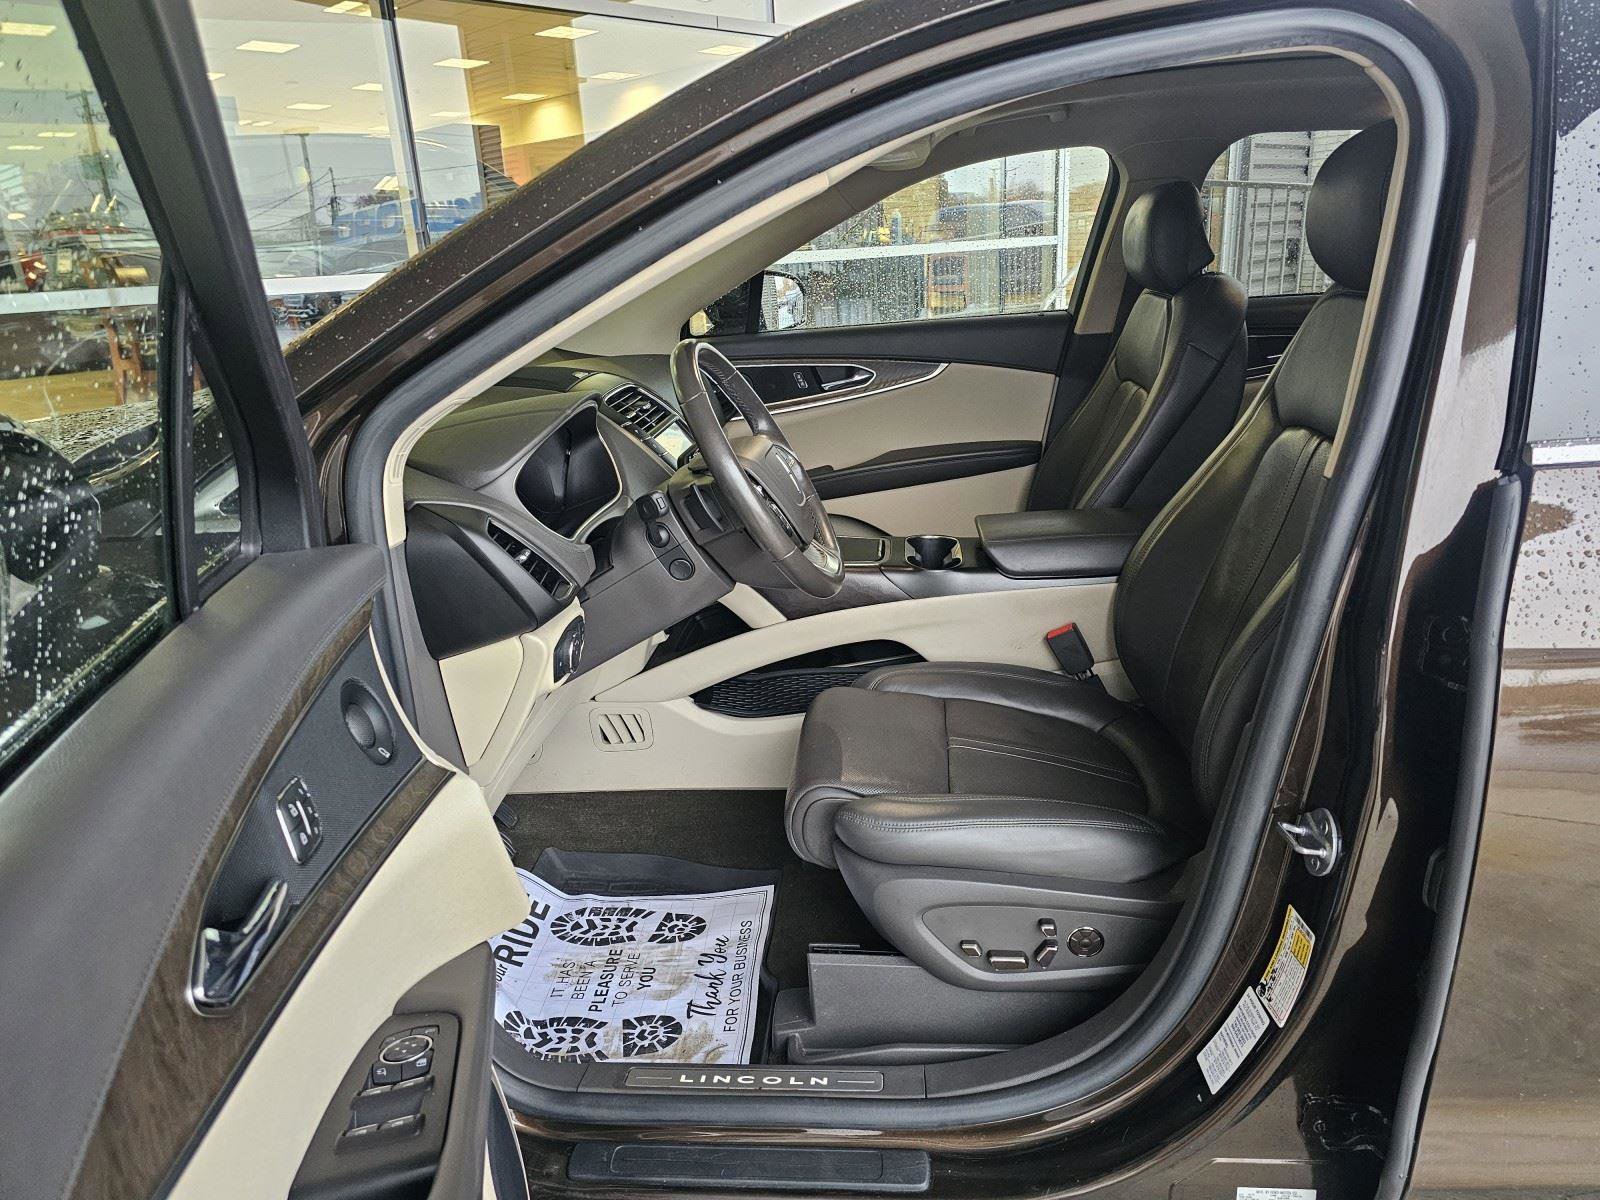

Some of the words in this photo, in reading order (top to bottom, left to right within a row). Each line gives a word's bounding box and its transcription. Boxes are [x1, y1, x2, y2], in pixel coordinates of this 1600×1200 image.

[697, 934, 729, 967] You
[733, 920, 752, 971] BUSINESS
[556, 961, 576, 984] HAS
[571, 971, 594, 1000] BEEN
[585, 960, 597, 968] A
[588, 949, 623, 1012] PLEASURE
[618, 953, 641, 987] SERVE
[636, 967, 656, 991] YOU
[550, 987, 565, 998] IT
[611, 991, 628, 1008] TO
[686, 968, 727, 1019] Thank
[727, 973, 744, 1006] YOUR
[723, 1007, 739, 1032] FOR
[679, 1074, 829, 1086] LINCOLN
